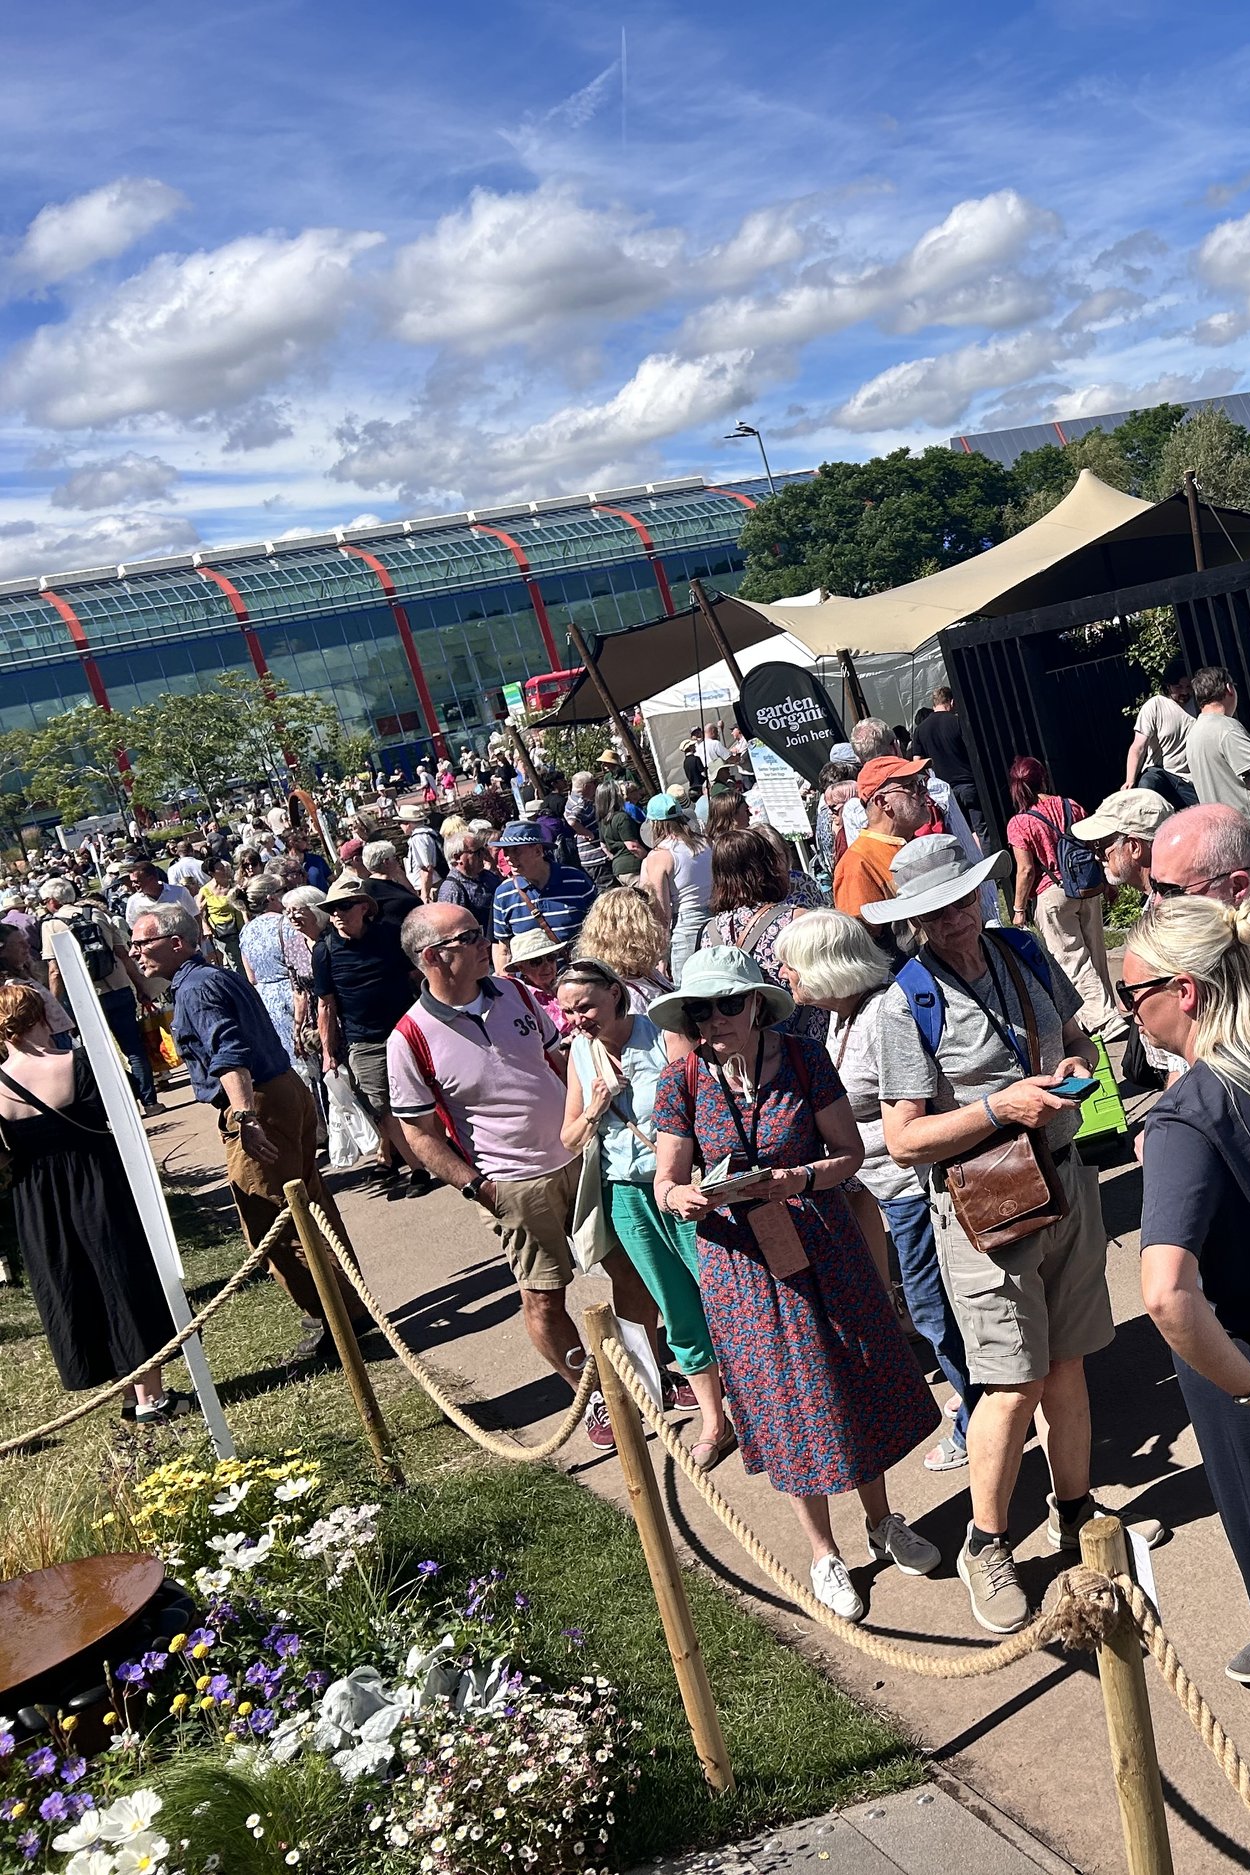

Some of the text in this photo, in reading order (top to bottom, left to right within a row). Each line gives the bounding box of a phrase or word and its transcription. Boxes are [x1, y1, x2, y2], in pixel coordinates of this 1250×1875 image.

[756, 696, 815, 724] garden
[768, 704, 828, 732] organic
[785, 728, 835, 748] Join here
[513, 1014, 537, 1036] 36
